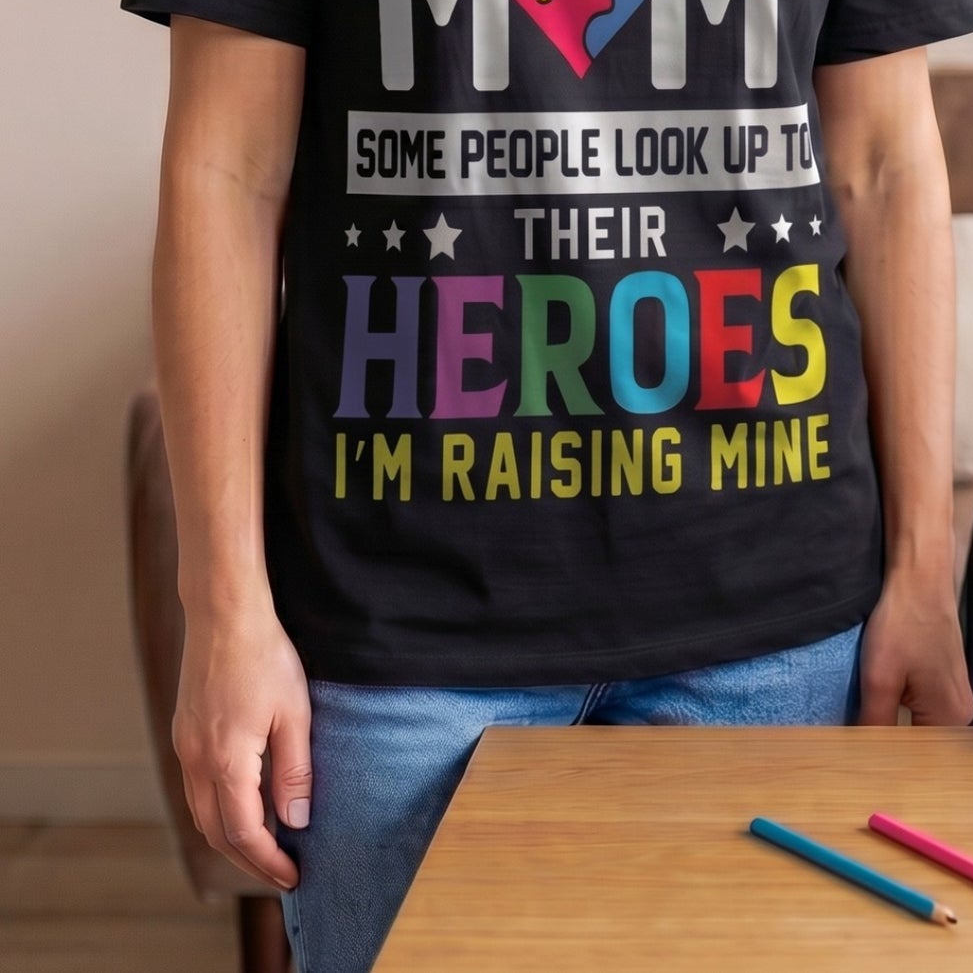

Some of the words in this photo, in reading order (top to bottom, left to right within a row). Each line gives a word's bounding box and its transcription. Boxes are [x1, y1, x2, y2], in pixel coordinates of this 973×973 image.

[356, 129, 446, 179] SOME
[461, 129, 600, 178] PEOPLE
[615, 126, 709, 175] LOOK
[723, 125, 769, 174] UP
[514, 206, 667, 260] THEIR
[332, 263, 827, 419] HEROES
[335, 433, 412, 501] I'M
[442, 427, 682, 501] RAISING
[711, 414, 831, 491] MINE
